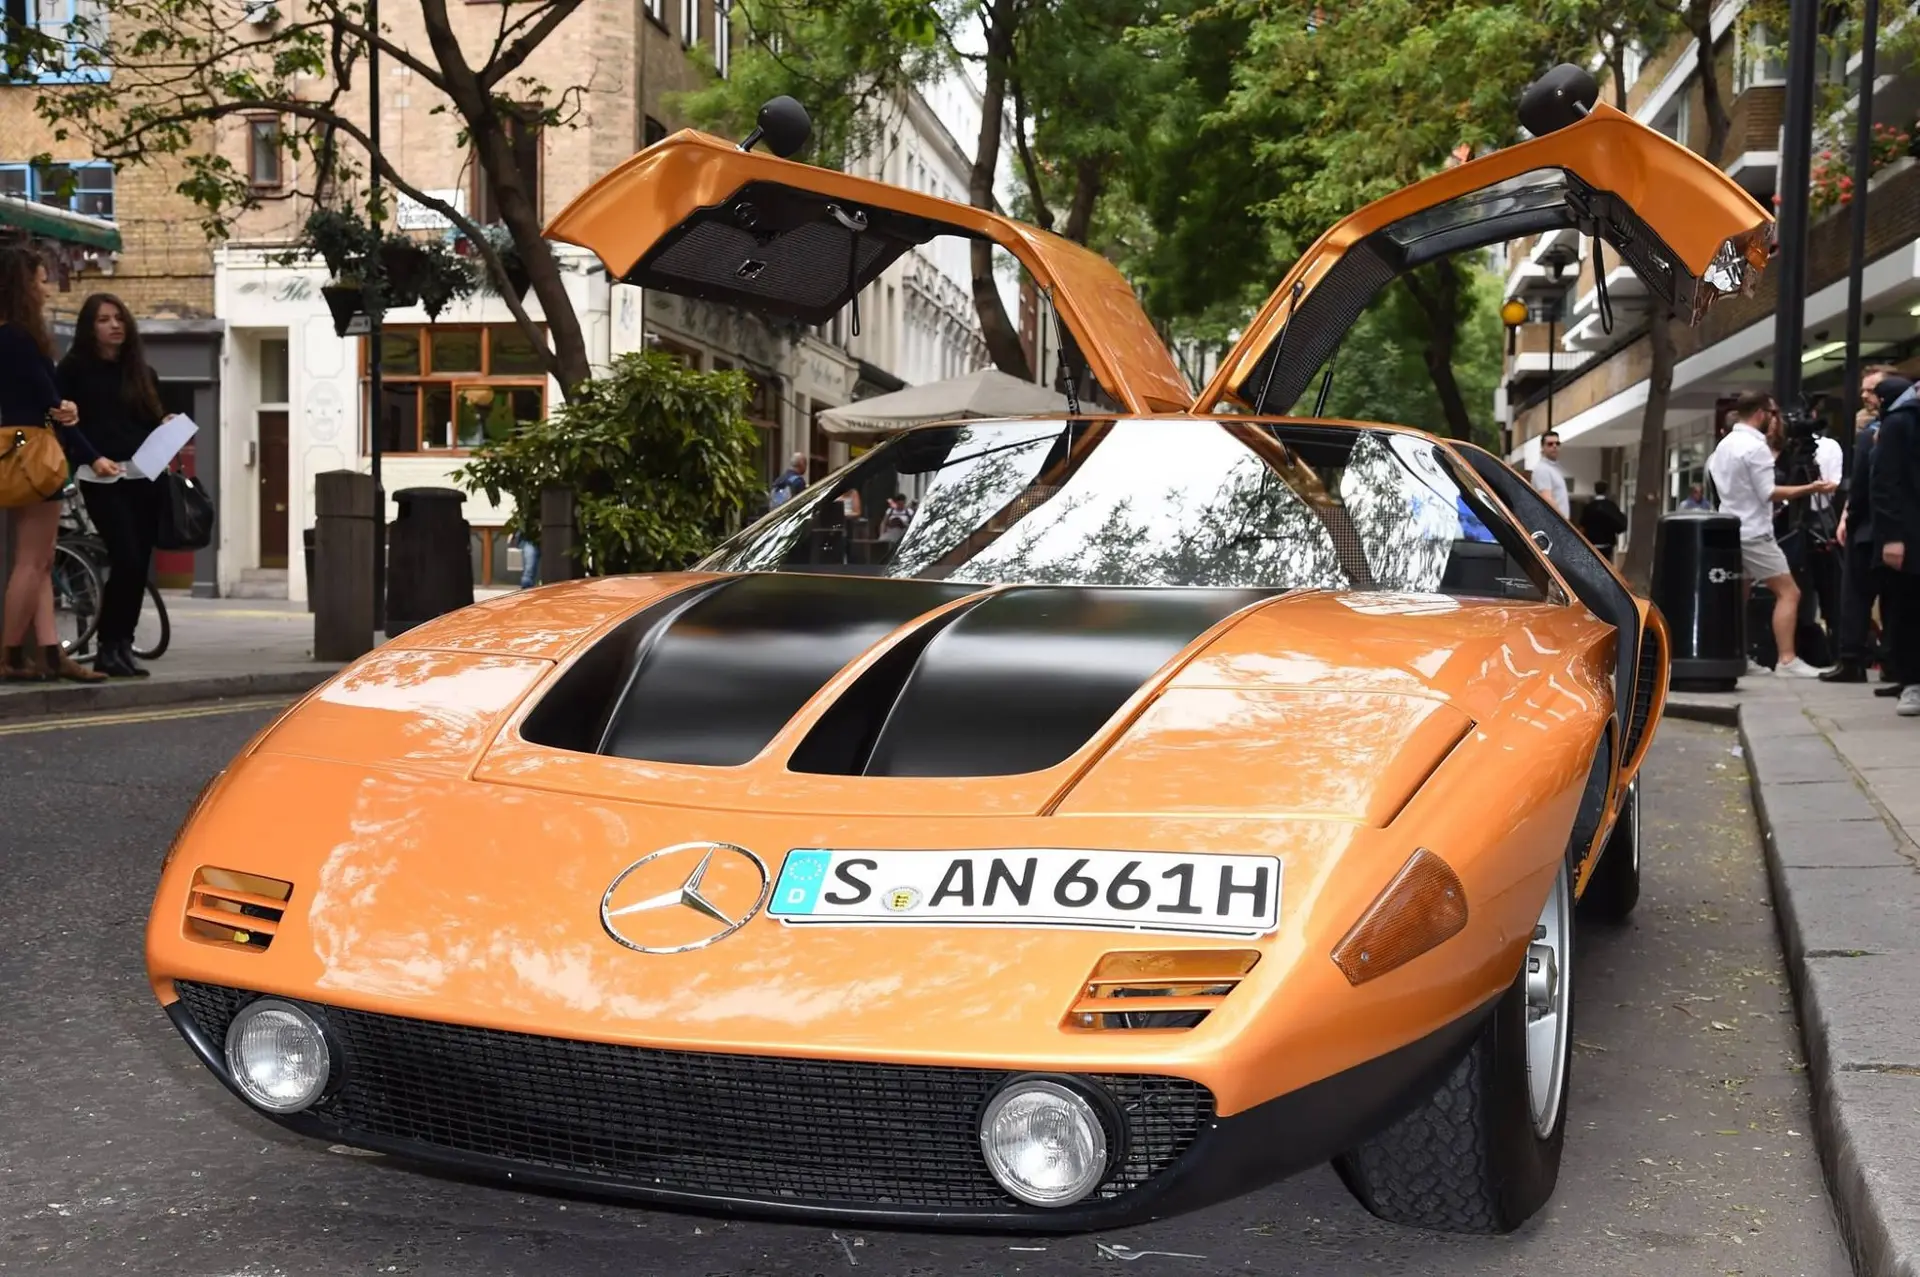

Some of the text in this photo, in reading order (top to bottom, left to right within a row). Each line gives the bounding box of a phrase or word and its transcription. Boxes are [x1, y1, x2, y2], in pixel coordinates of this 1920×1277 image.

[787, 888, 806, 904] D
[824, 858, 878, 905] S
[928, 857, 1038, 907] AN
[1053, 858, 1269, 918] 661H
